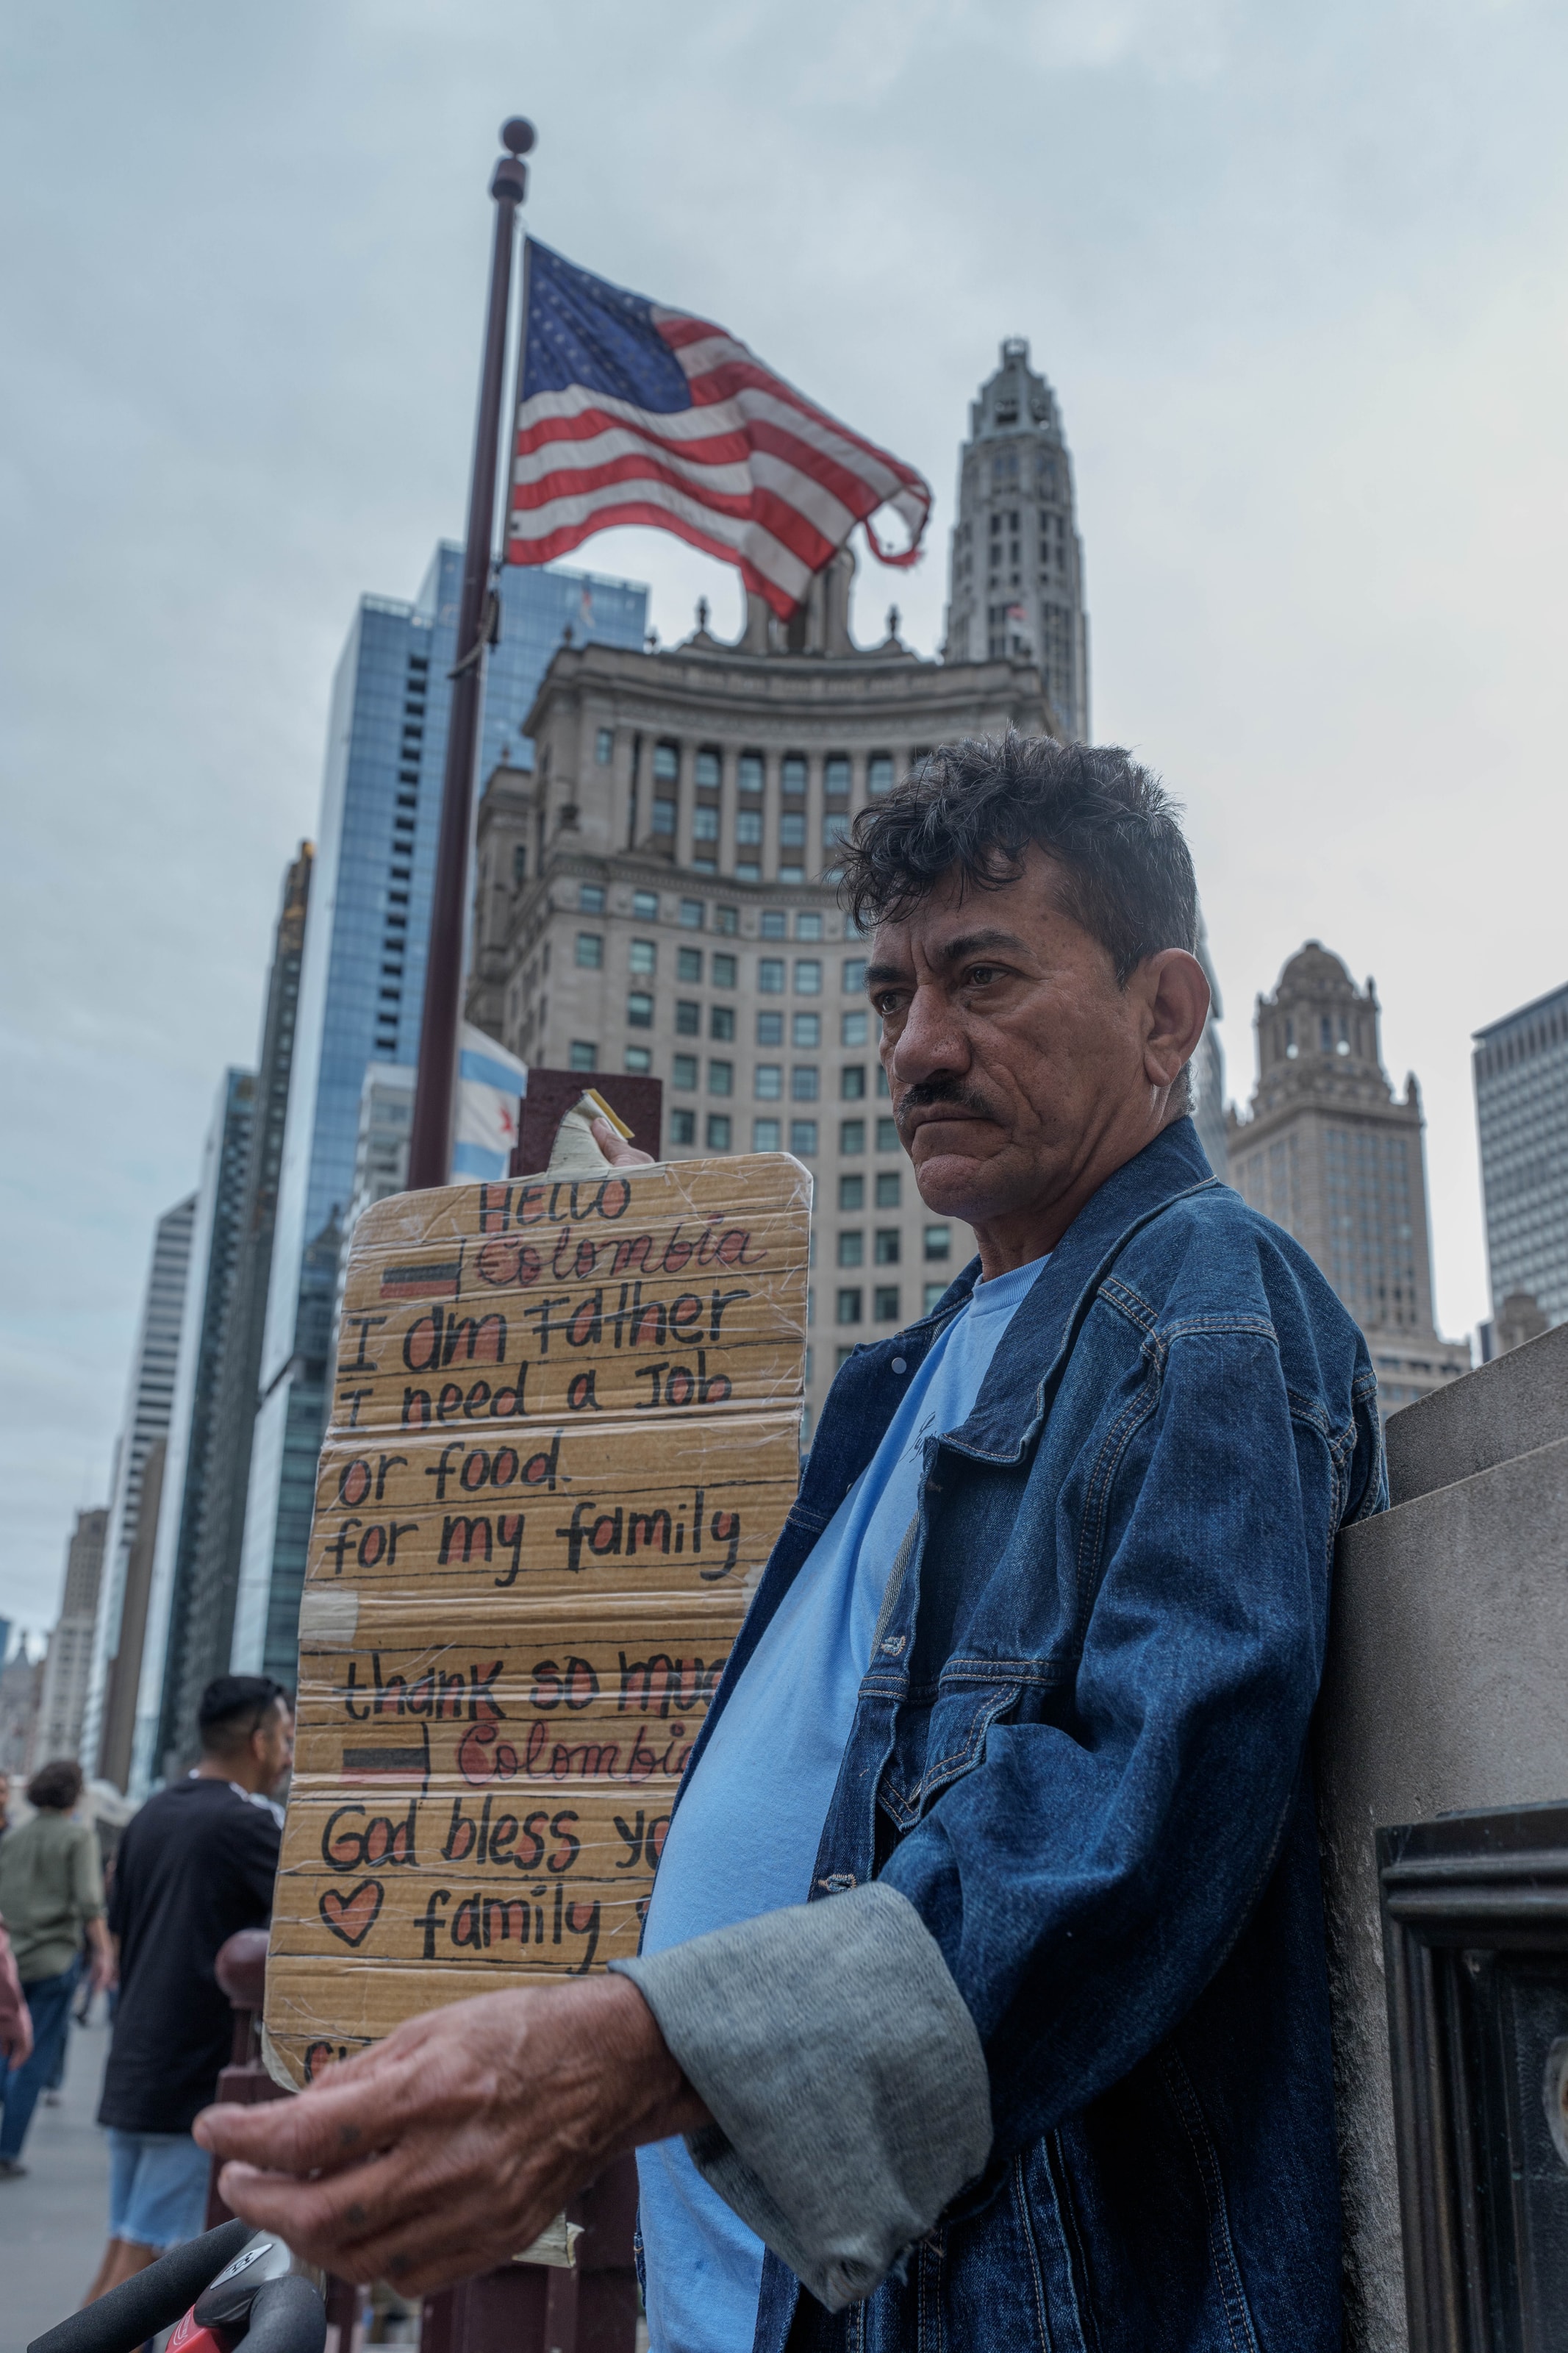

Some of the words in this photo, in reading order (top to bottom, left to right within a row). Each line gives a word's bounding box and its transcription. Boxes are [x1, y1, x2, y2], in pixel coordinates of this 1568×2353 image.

[475, 1213, 767, 1287] Colombia
[338, 1316, 387, 1372] I
[403, 1304, 507, 1372] am
[524, 1280, 751, 1354] Father
[333, 1388, 373, 1435] I
[401, 1360, 528, 1431] need
[567, 1370, 601, 1411] a
[339, 1454, 407, 1507] or
[325, 1518, 418, 1574] for
[437, 1512, 525, 1586] my
[556, 1485, 740, 1581] family
[619, 1651, 729, 1718] muc
[321, 1799, 420, 1873] God
[440, 1794, 580, 1873] bless
[613, 1810, 673, 1871] yo
[413, 1882, 601, 1976] family
